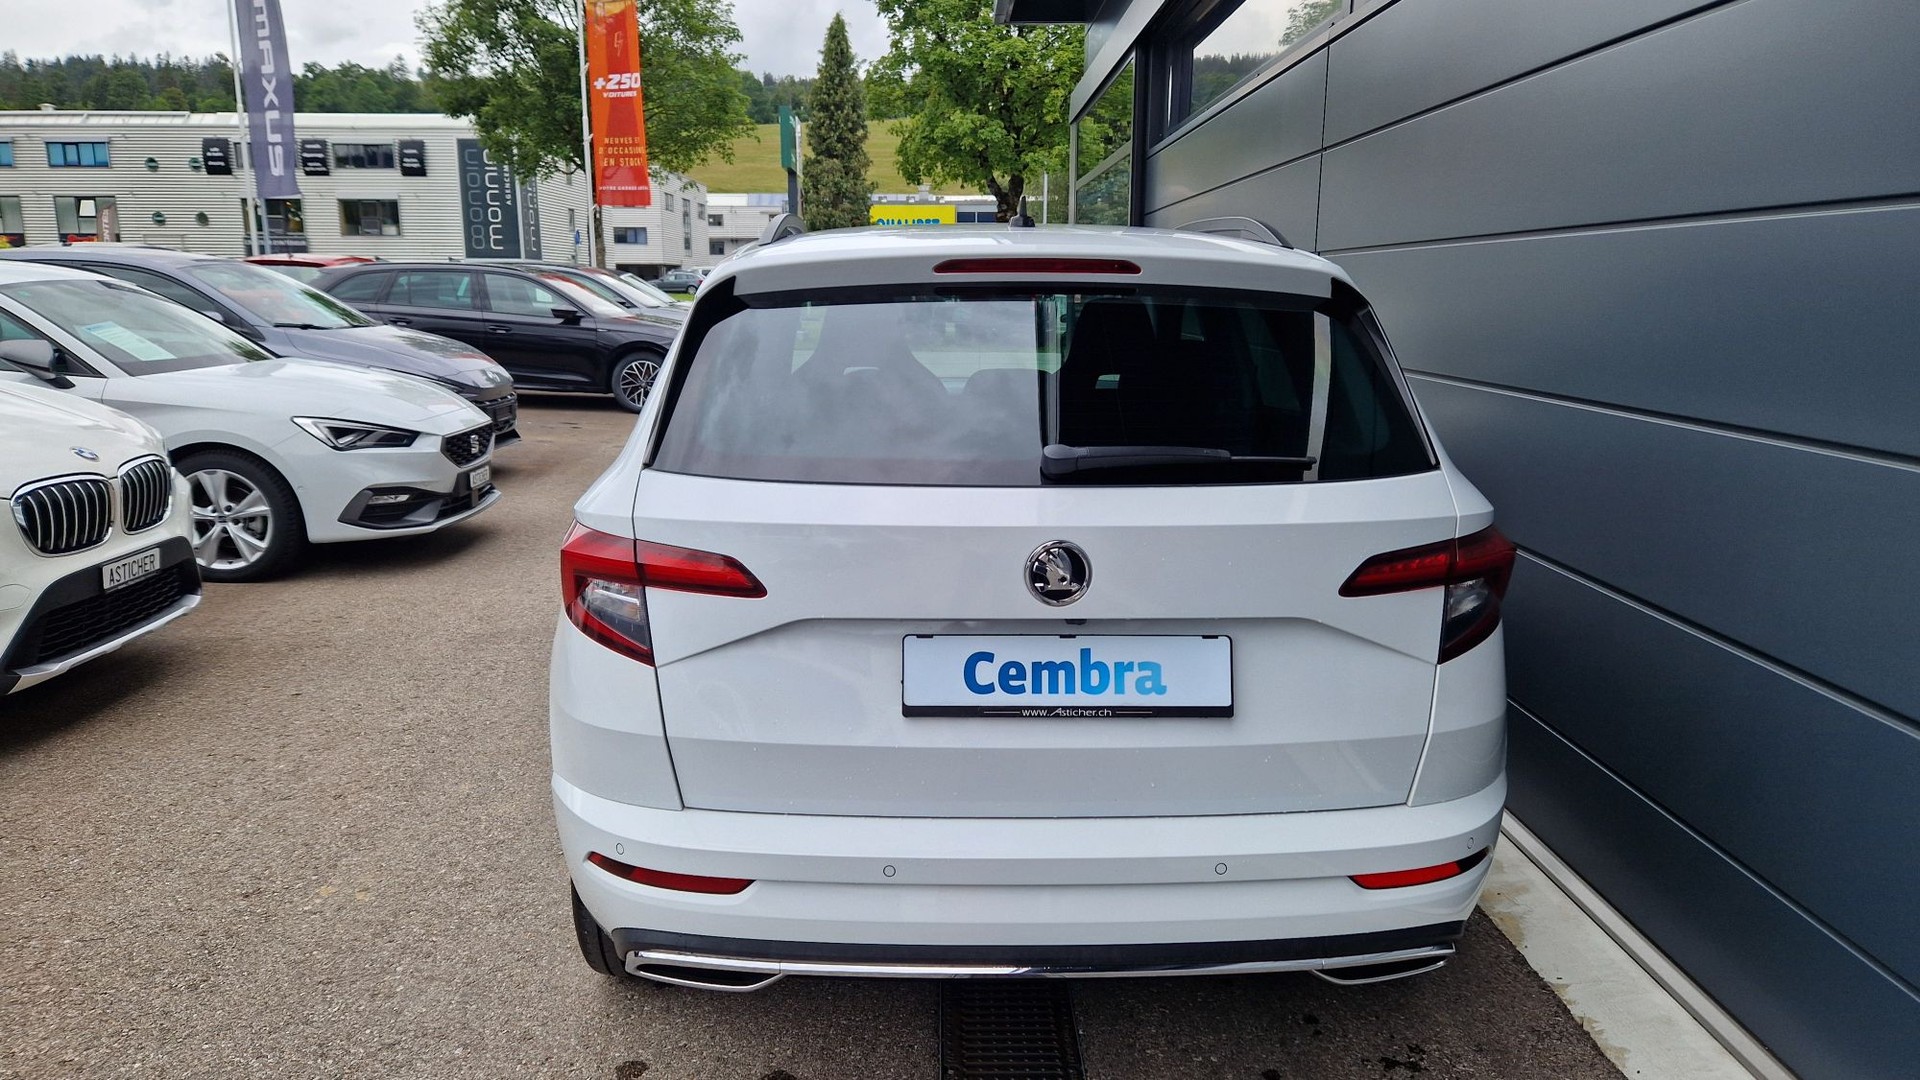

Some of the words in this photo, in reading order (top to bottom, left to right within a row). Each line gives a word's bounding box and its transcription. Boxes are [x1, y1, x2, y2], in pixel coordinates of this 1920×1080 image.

[593, 72, 641, 90] +250
[602, 90, 637, 98] VOITURES
[604, 136, 633, 145] NEUVES
[603, 157, 615, 167] EN
[108, 553, 156, 586] ASTICHER
[963, 647, 1168, 695] Cembra
[1021, 707, 1112, 717] www.Asticher.ch
